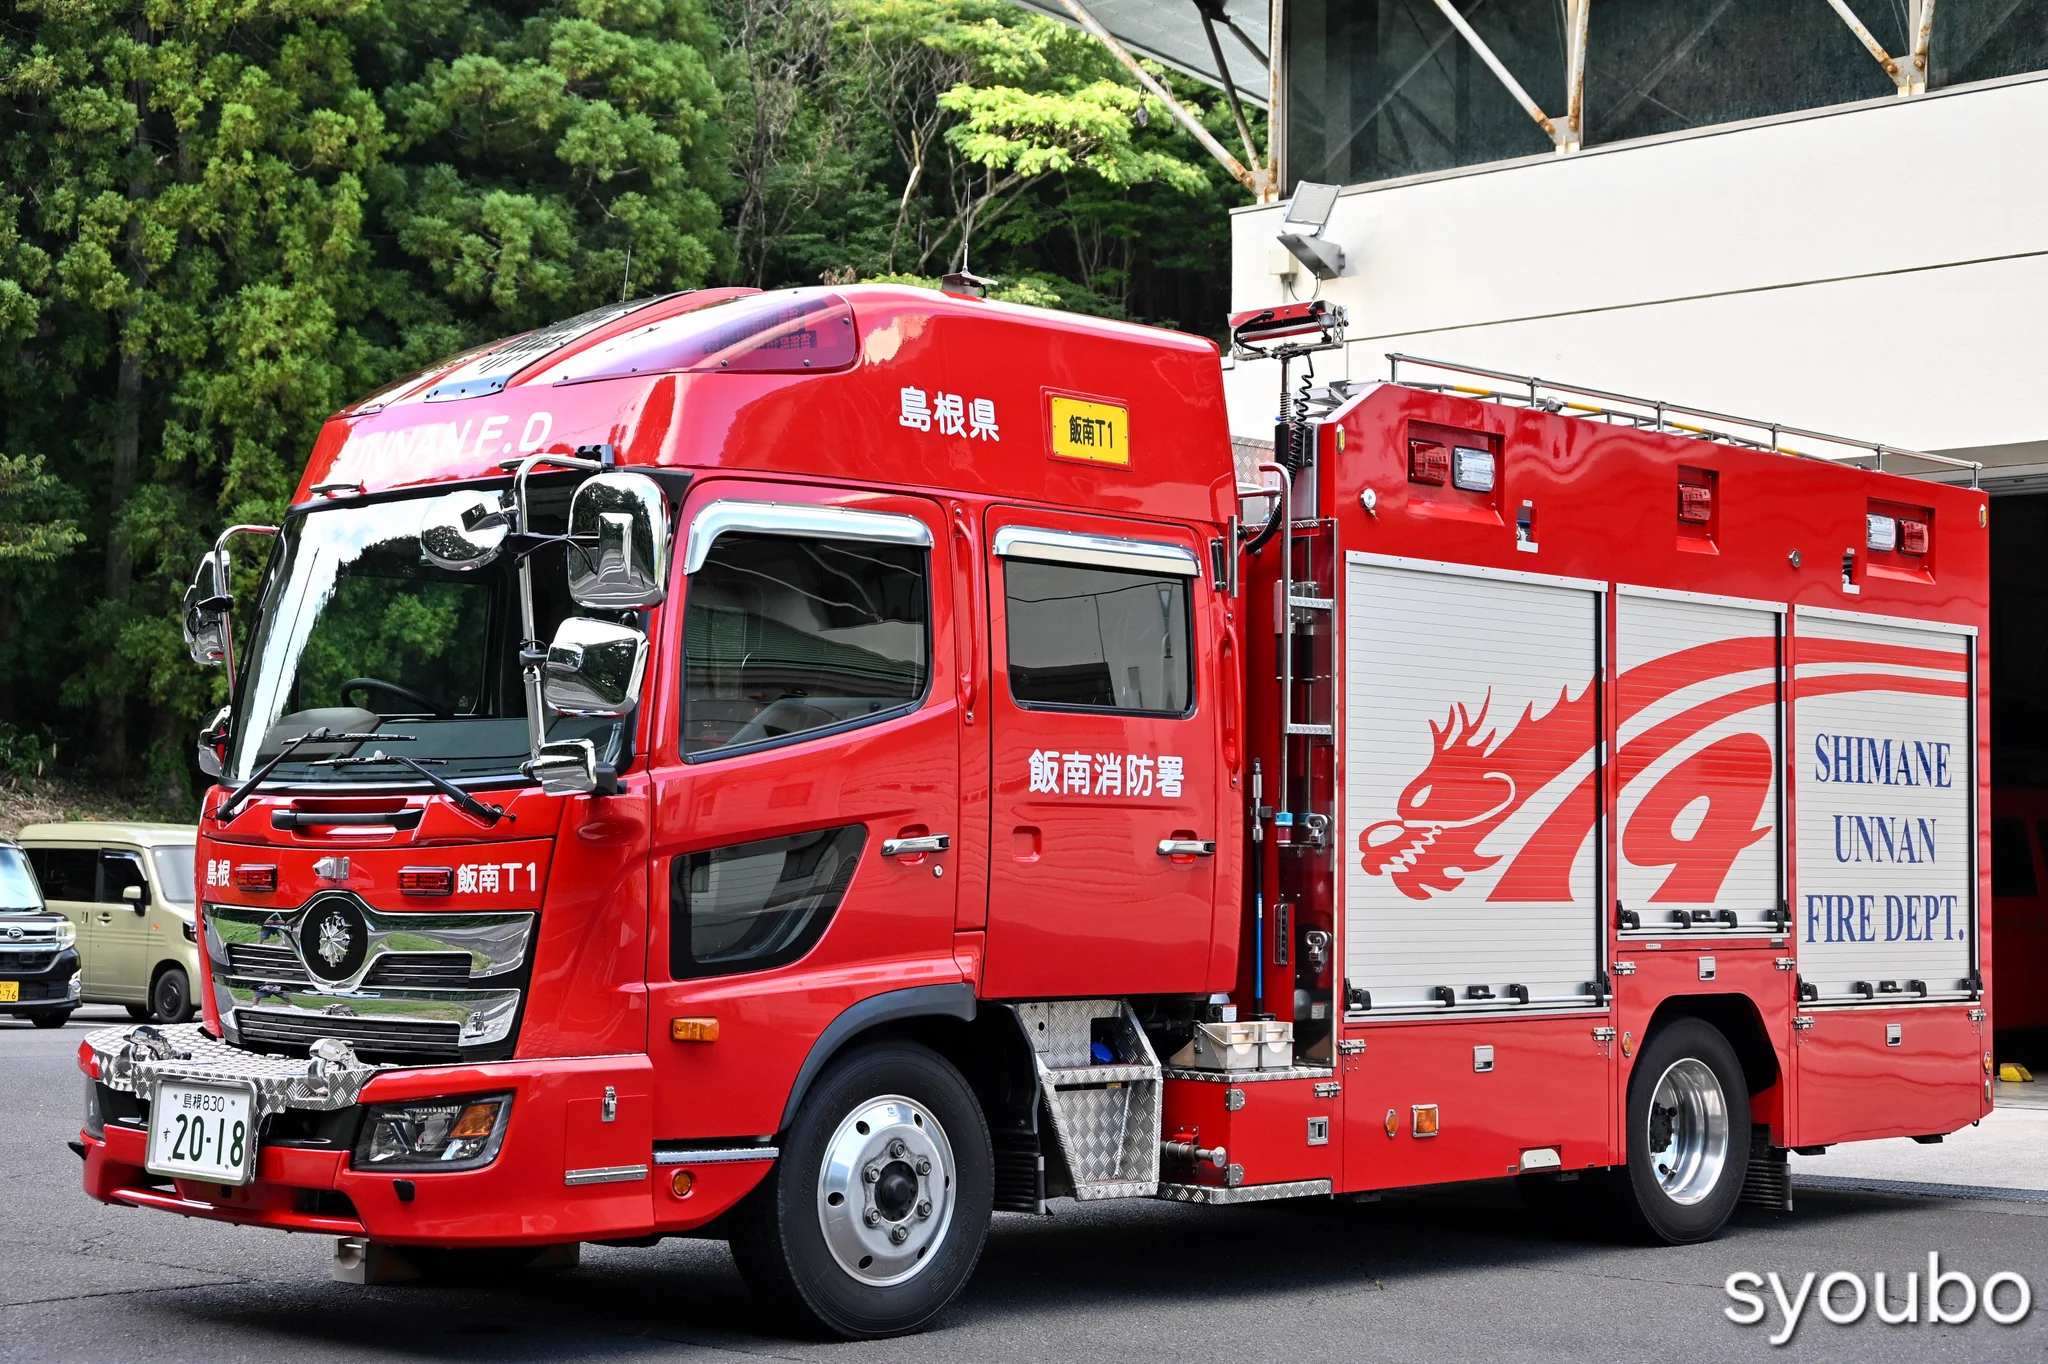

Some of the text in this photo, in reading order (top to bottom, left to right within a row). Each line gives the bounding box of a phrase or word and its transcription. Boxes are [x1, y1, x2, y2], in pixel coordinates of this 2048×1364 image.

[899, 385, 999, 442] 島根県
[1069, 414, 1113, 449] 飯南T1
[1028, 749, 1184, 797] 飯南消防署
[1815, 733, 1952, 787] SHIMANE
[1833, 815, 1937, 864] UNNAN
[206, 859, 231, 888] 島根
[456, 861, 537, 894] 飯南T1
[1805, 895, 1964, 943] FIRE DEPT.
